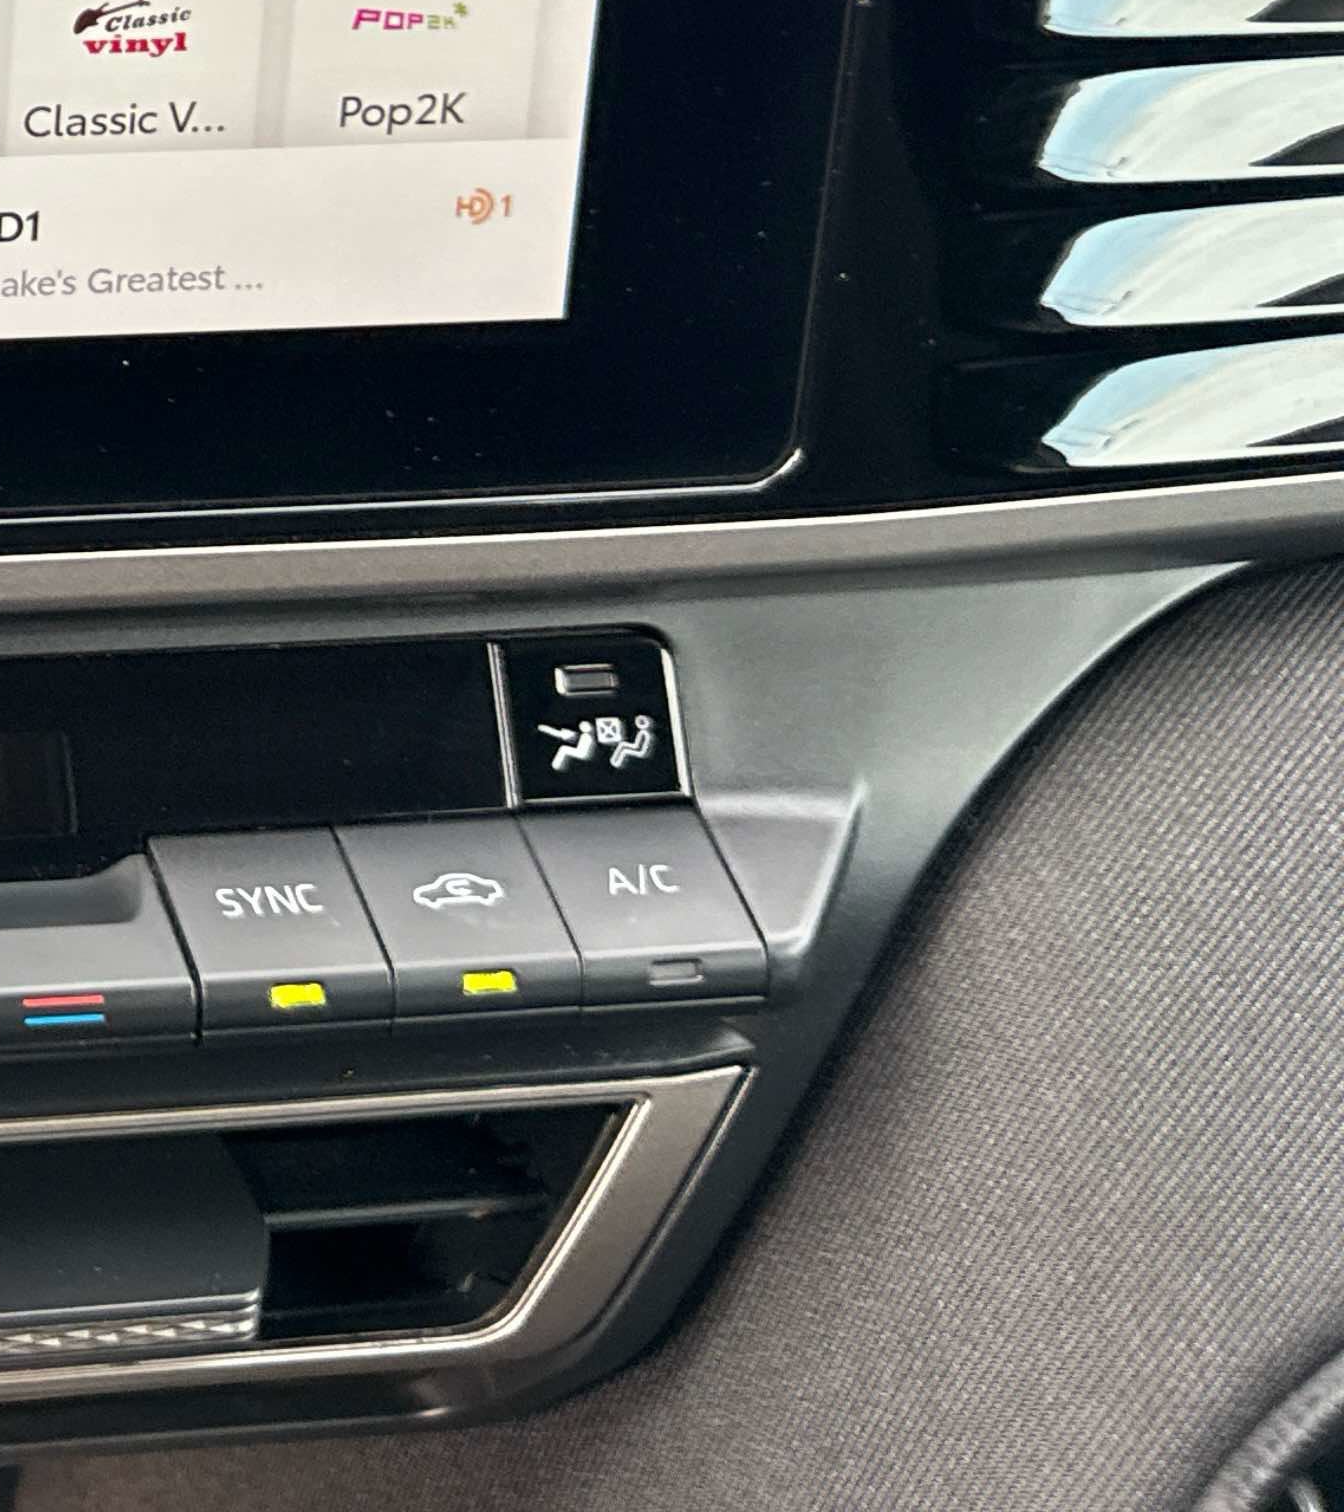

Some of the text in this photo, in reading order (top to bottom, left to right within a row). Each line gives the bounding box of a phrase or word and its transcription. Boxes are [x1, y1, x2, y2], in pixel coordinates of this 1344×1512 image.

[105, 7, 192, 33] Classic
[82, 33, 187, 57] vinyl
[25, 104, 157, 137] Classic
[340, 93, 464, 130] Pop2K
[88, 266, 225, 293] Greatest
[609, 864, 679, 895] A/C
[216, 884, 323, 918] SYNC
